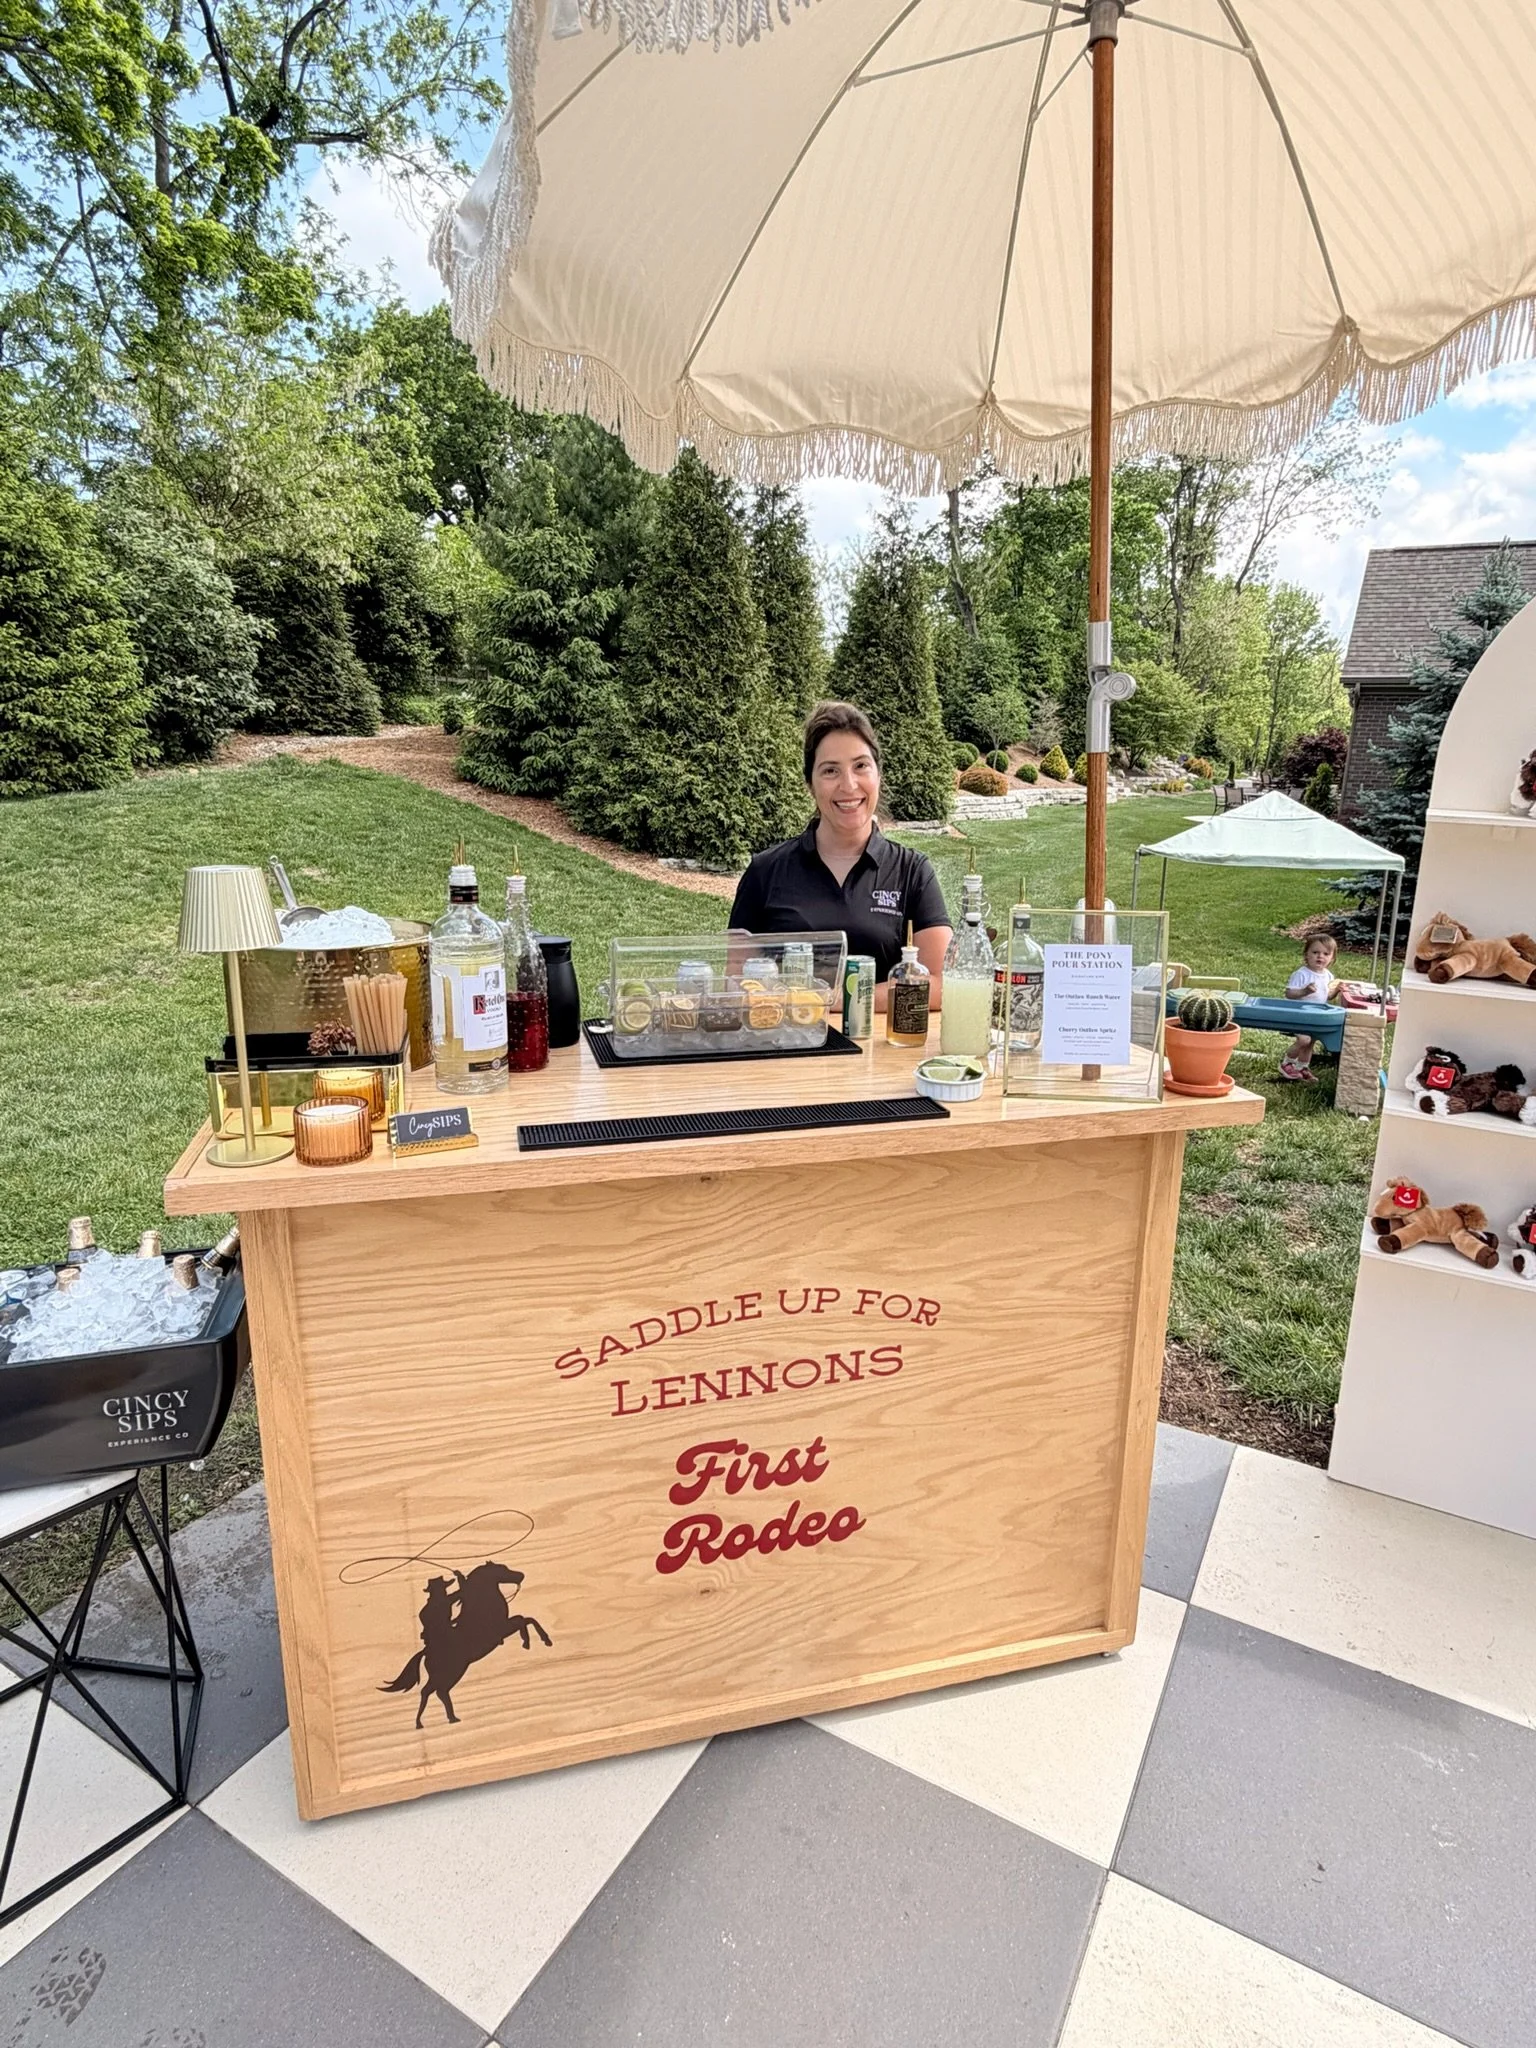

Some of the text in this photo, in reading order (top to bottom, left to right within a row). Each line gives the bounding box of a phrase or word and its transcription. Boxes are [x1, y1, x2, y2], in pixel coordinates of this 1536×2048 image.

[872, 890, 902, 901] CINCY
[877, 899, 897, 907] SIPS
[1052, 960, 1123, 969] POUR STATION
[1064, 951, 1113, 960] THE PONY
[554, 1287, 941, 1379] SADDLE UP FOR
[610, 1344, 904, 1417] LENNONS
[102, 1389, 189, 1417] CINCY
[118, 1409, 178, 1433] SIPS
[107, 1434, 171, 1448] EXPERIENCE
[668, 1435, 831, 1506] First
[655, 1499, 867, 1575] Rodeo
